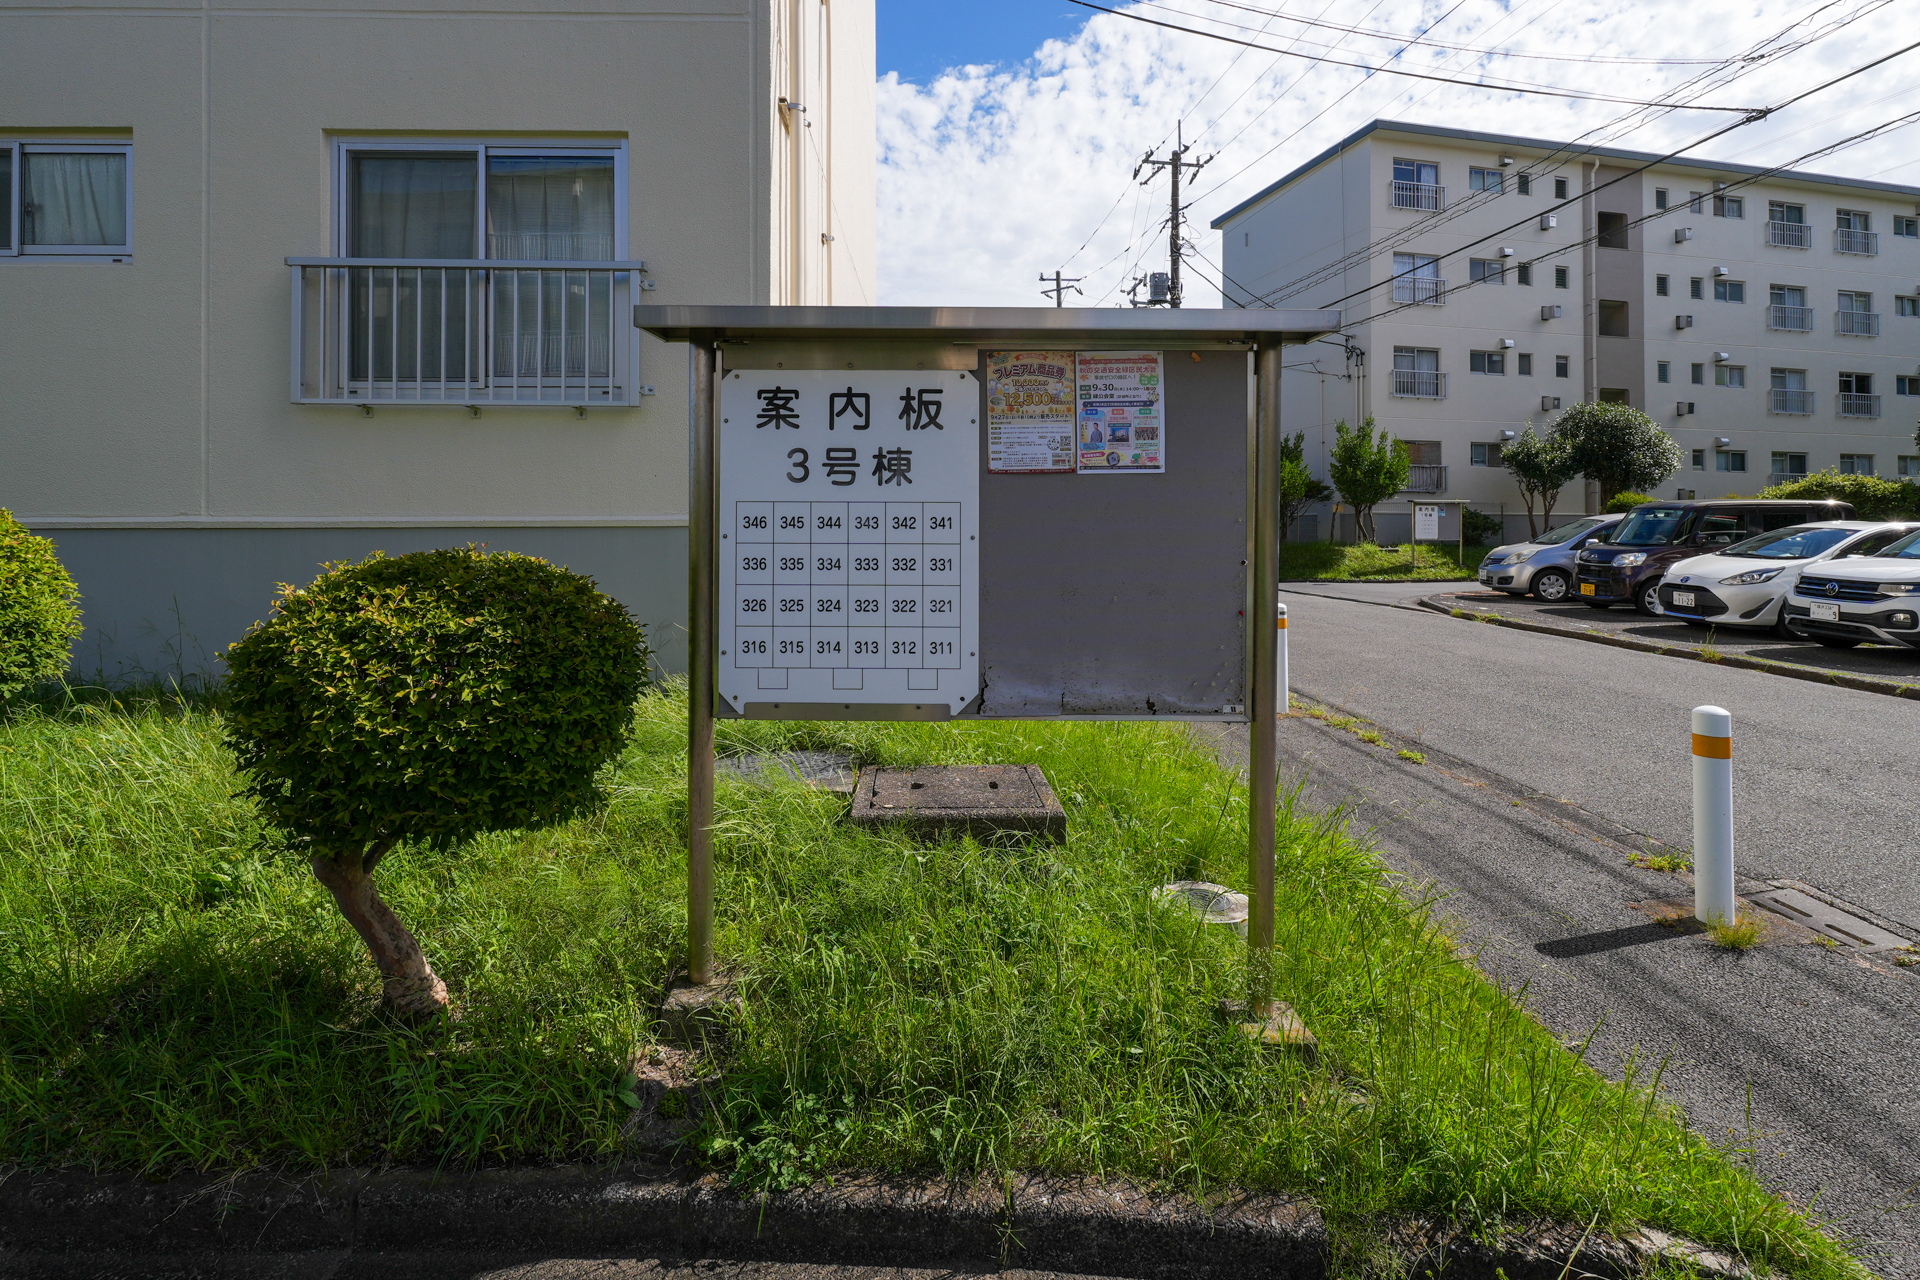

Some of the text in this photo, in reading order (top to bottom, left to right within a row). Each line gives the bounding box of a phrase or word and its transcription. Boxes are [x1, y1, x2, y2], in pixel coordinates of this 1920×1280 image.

[756, 386, 943, 431] 案内板
[787, 447, 912, 486] 3号棟
[743, 516, 951, 529] 346 345 344 343 342 341
[743, 557, 951, 571] 336 335 334 333 332 331
[743, 599, 951, 612] 326 325 324 323 322 321
[742, 641, 951, 654] 316 315 314 313 312 311
